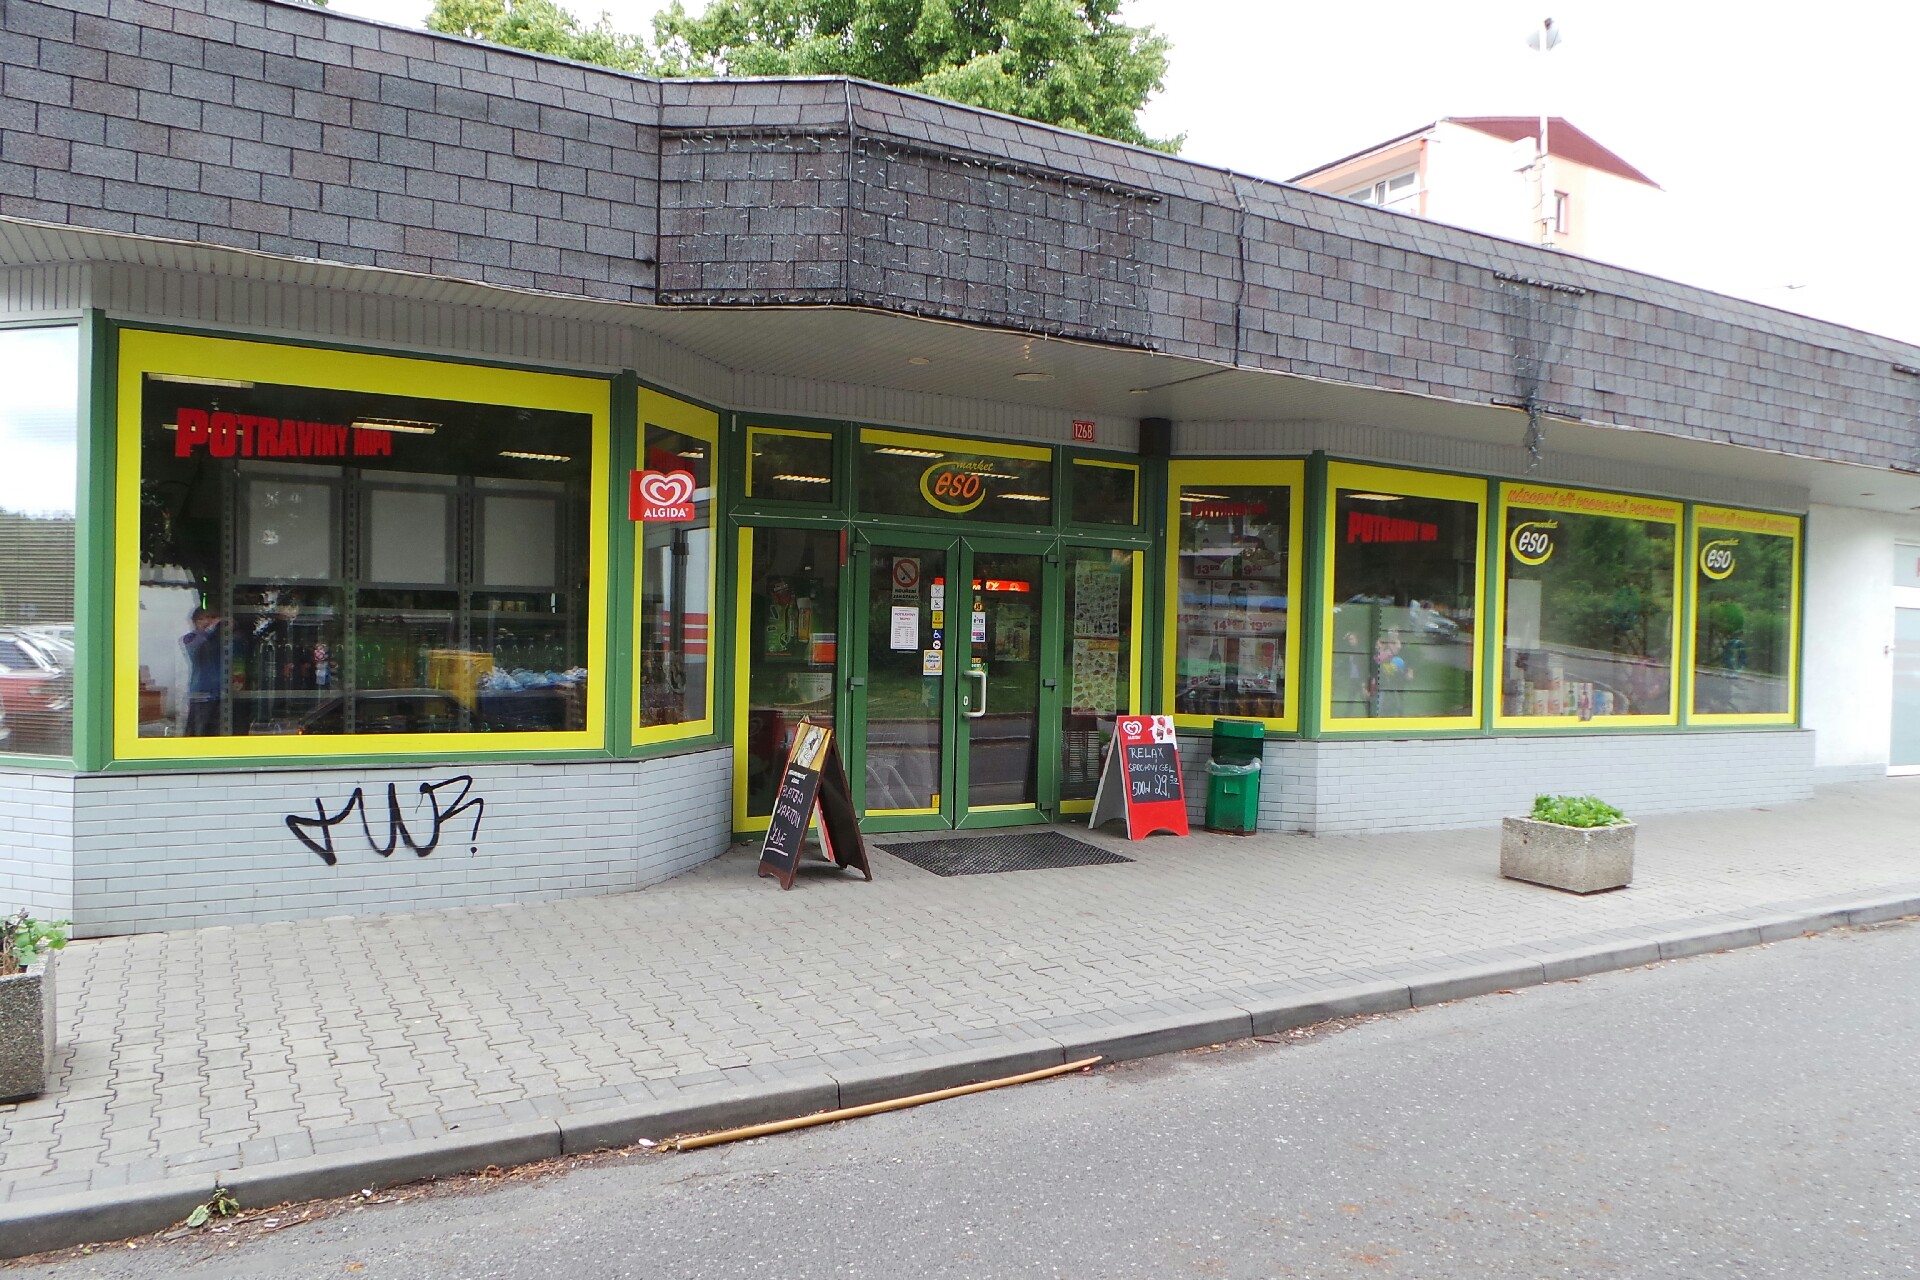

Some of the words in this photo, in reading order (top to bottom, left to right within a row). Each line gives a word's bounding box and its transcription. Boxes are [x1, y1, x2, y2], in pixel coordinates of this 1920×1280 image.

[175, 407, 348, 457] POTRAVINY
[957, 460, 994, 472] market
[934, 471, 981, 498] eso
[643, 507, 687, 518] ALGIDA
[1518, 531, 1549, 553] eso
[1706, 549, 1731, 568] eso
[1128, 747, 1164, 760] RELAX
